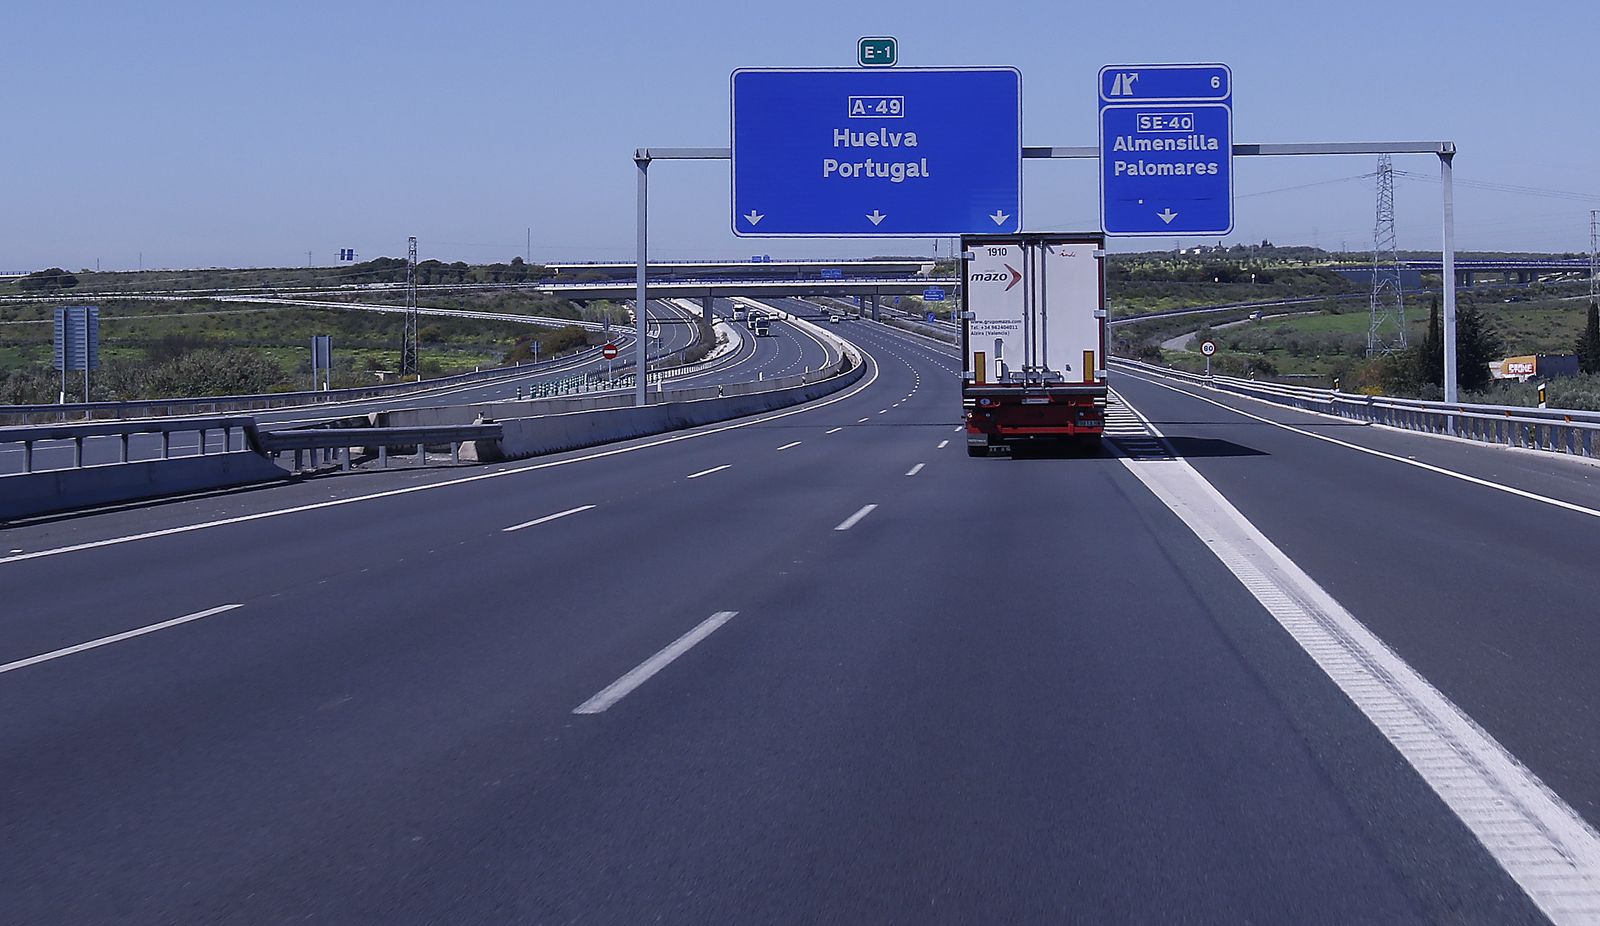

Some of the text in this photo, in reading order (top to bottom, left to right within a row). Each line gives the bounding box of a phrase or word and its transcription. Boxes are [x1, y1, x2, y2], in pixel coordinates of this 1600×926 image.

[865, 46, 891, 58] E-1
[1210, 76, 1220, 88] 6
[852, 99, 901, 114] A-49
[1140, 116, 1191, 129] SE-40
[833, 128, 918, 147] Huelva
[1113, 135, 1219, 152] Almensilla
[823, 158, 929, 182] Portugal
[1114, 160, 1218, 176] Palomares
[987, 247, 1007, 257] 1910
[970, 273, 1008, 281] mazo
